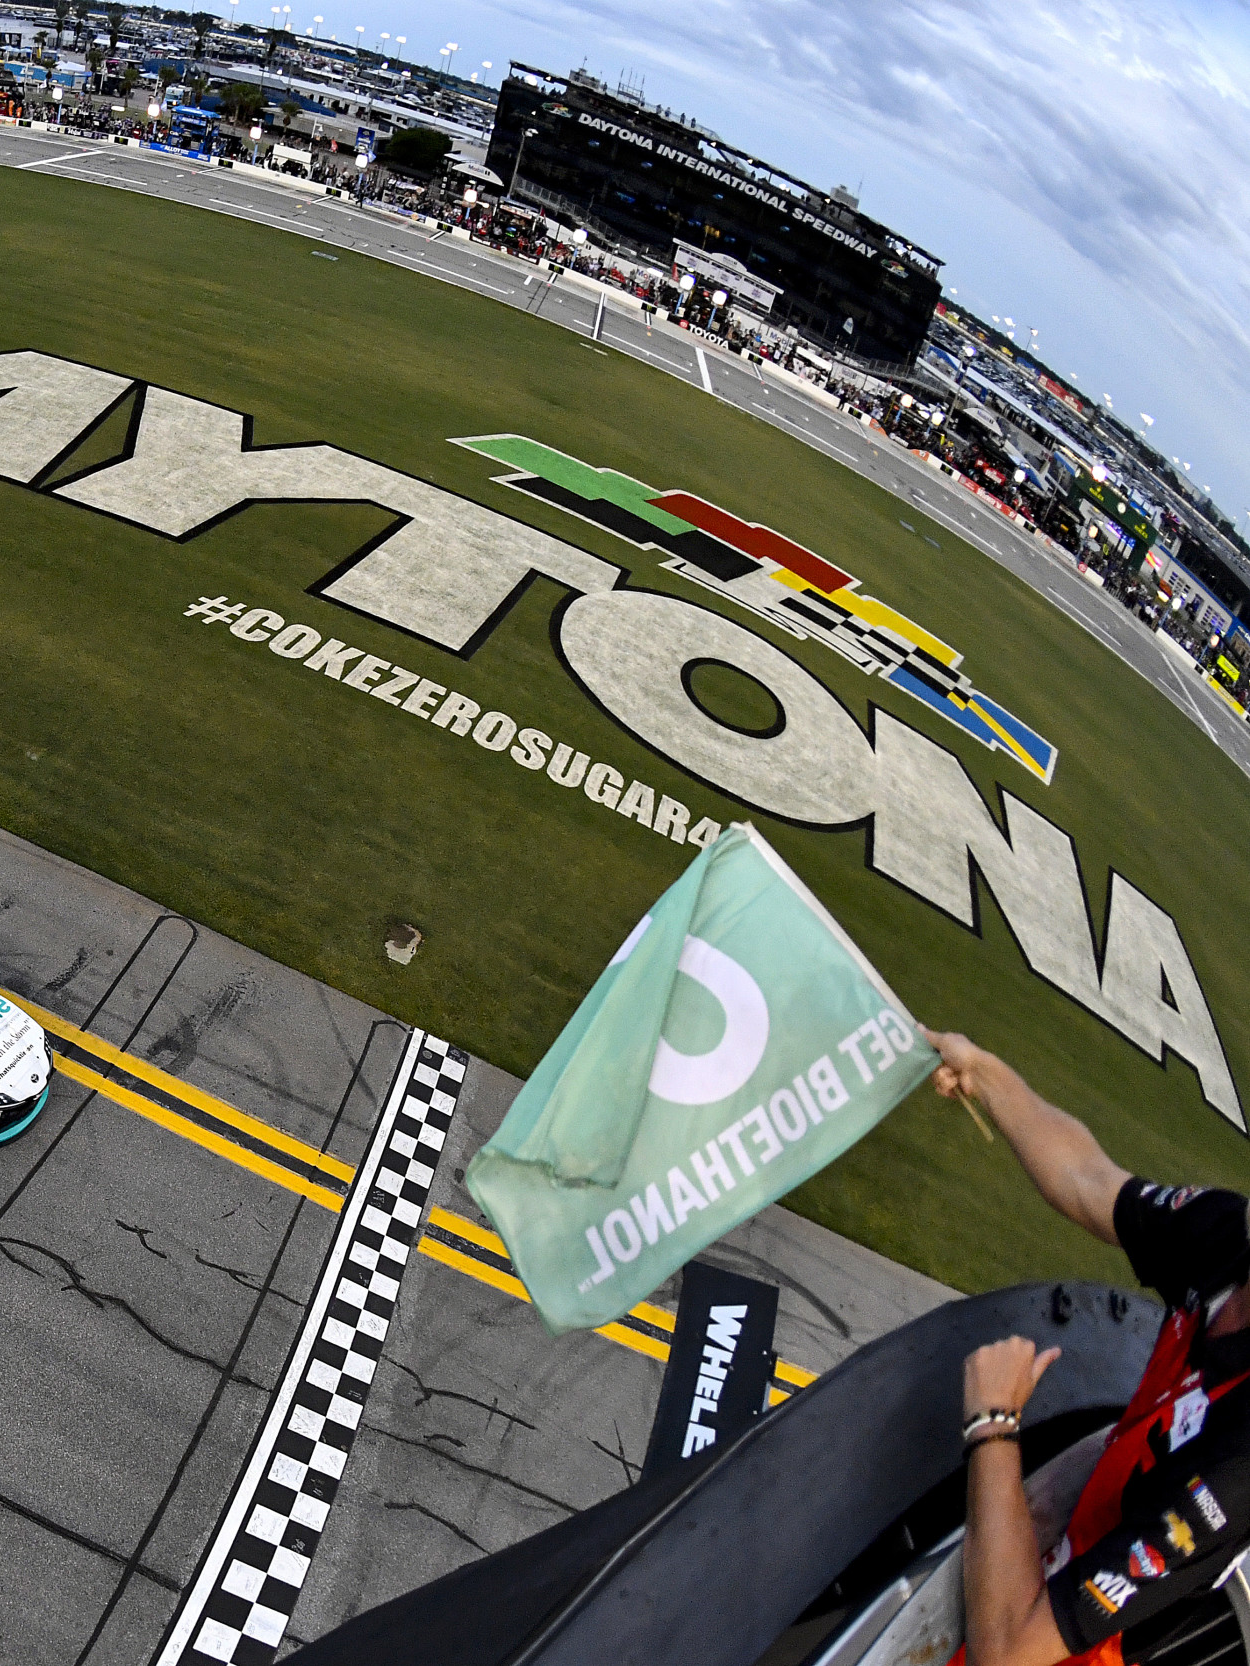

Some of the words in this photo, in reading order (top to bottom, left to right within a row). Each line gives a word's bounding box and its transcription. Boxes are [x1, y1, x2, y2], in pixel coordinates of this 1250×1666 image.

[578, 112, 653, 151] DAYTONA
[656, 144, 788, 213] INTERNATIONAL
[792, 207, 878, 259] SPEEDWAY
[688, 324, 730, 350] TOYOTA
[183, 595, 721, 851] #COKEZEROSUGAR4
[3, 1037, 15, 1052] the
[680, 1304, 749, 1459] WHELE
[1194, 1484, 1227, 1532] NASCAR
[1093, 1571, 1138, 1608] WIX
